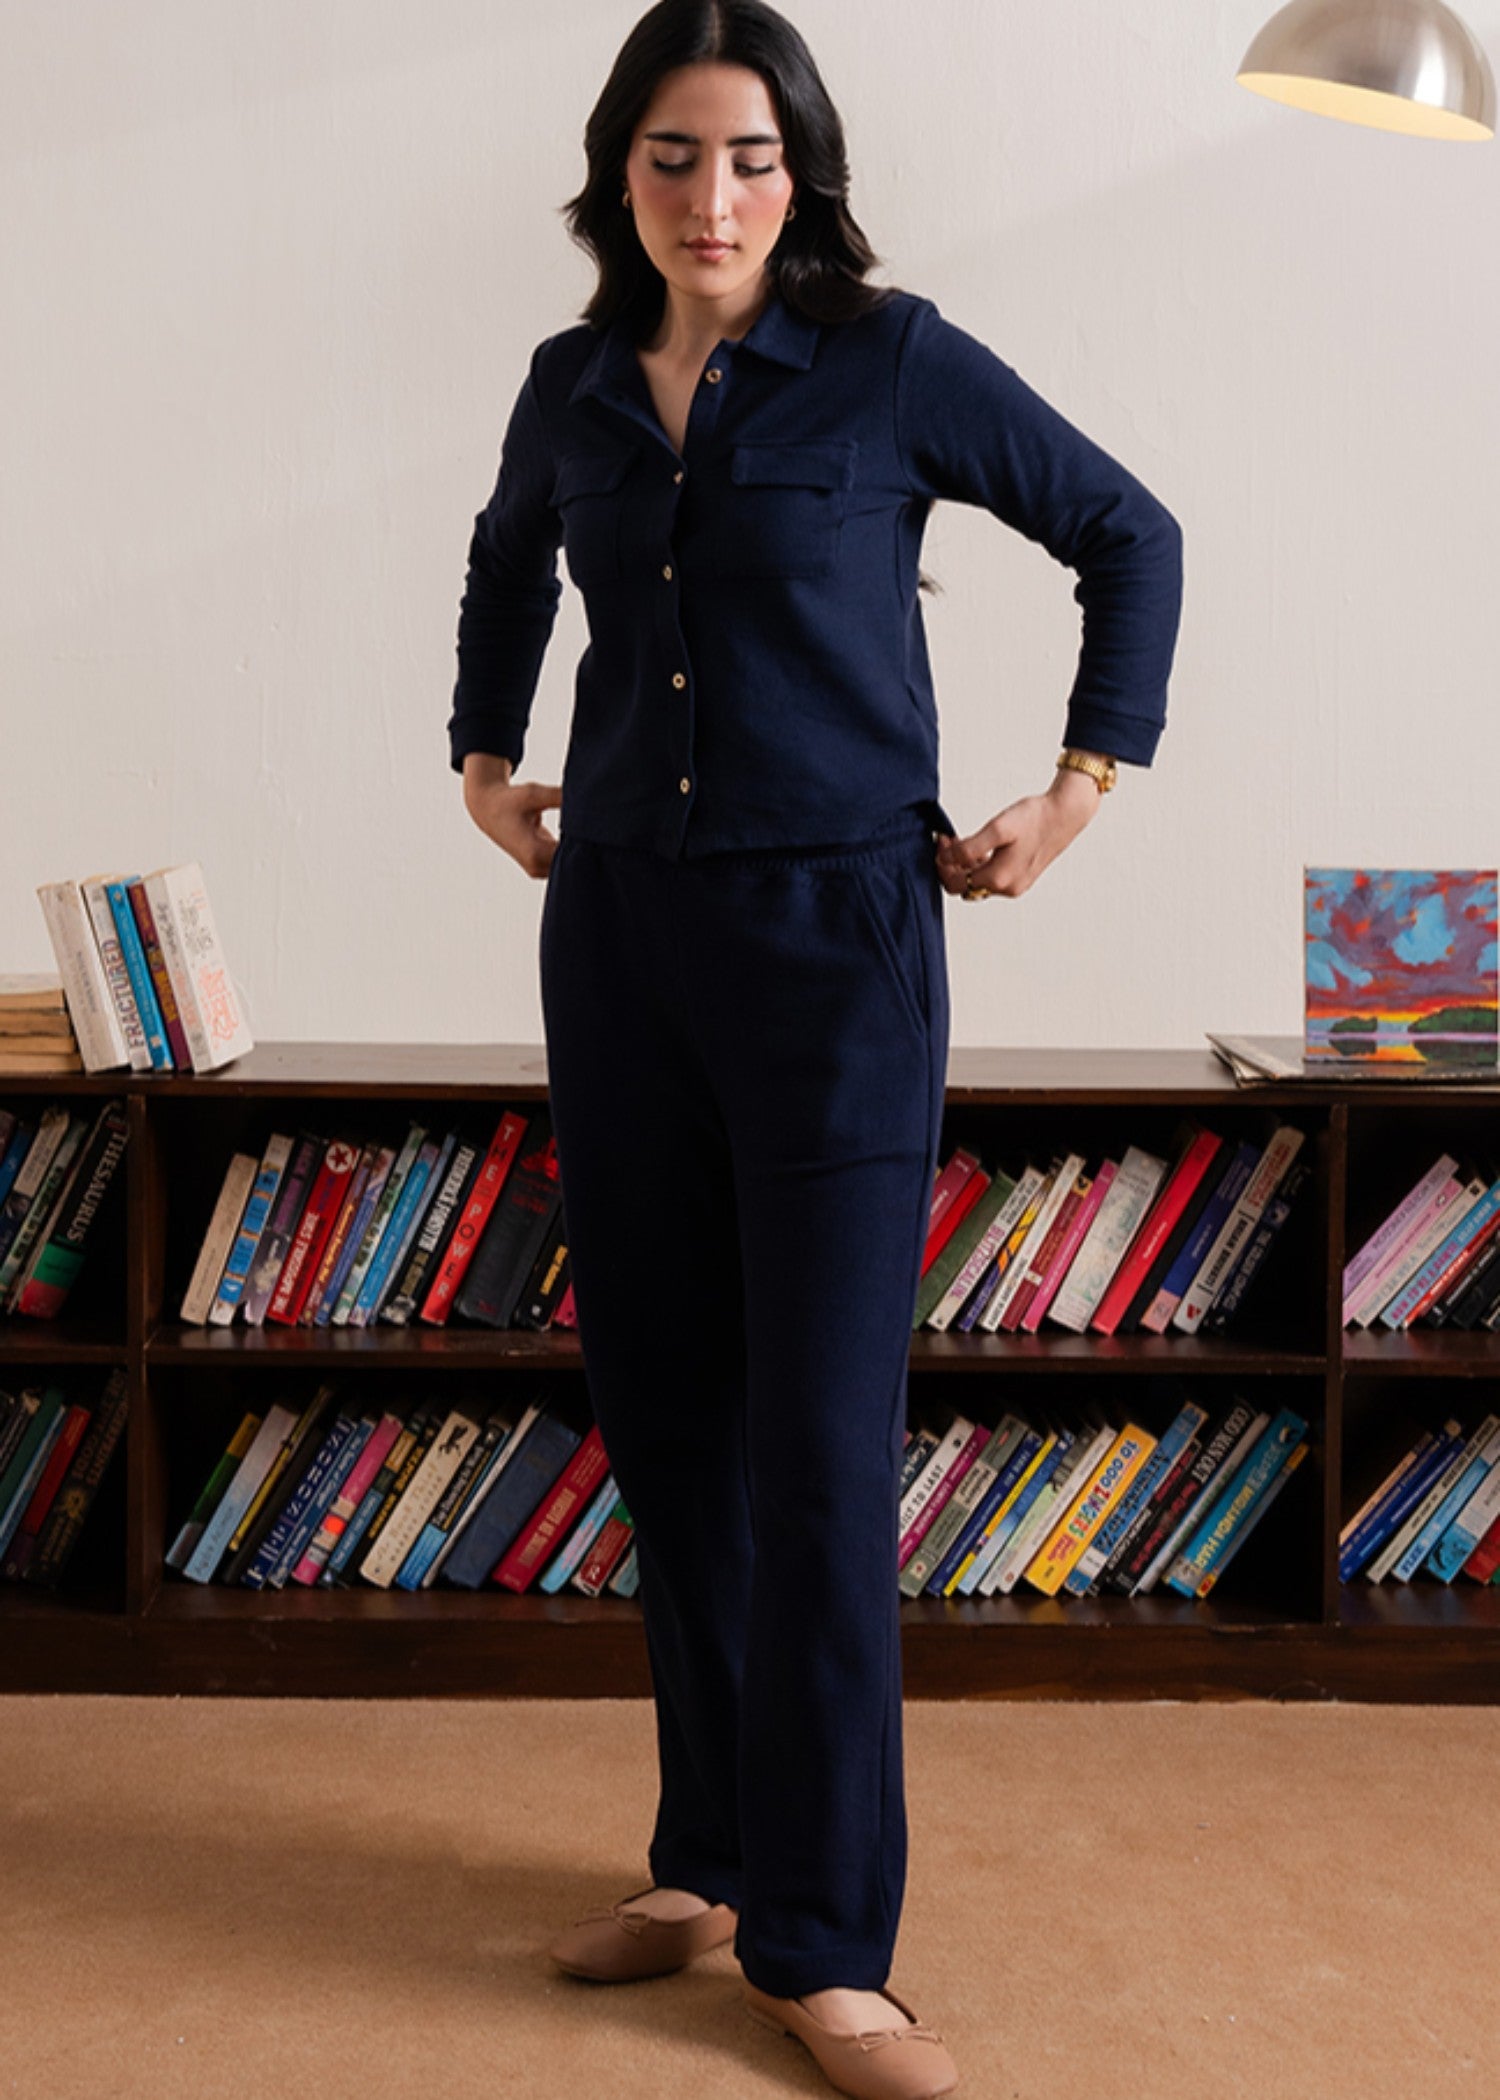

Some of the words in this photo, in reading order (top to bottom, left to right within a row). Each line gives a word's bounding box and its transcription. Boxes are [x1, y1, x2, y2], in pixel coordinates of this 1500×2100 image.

[102, 939, 144, 1048] FRACTURED
[67, 1132, 128, 1243] THESAURUS
[486, 1125, 515, 1181] THE
[438, 1205, 482, 1298] POWER
